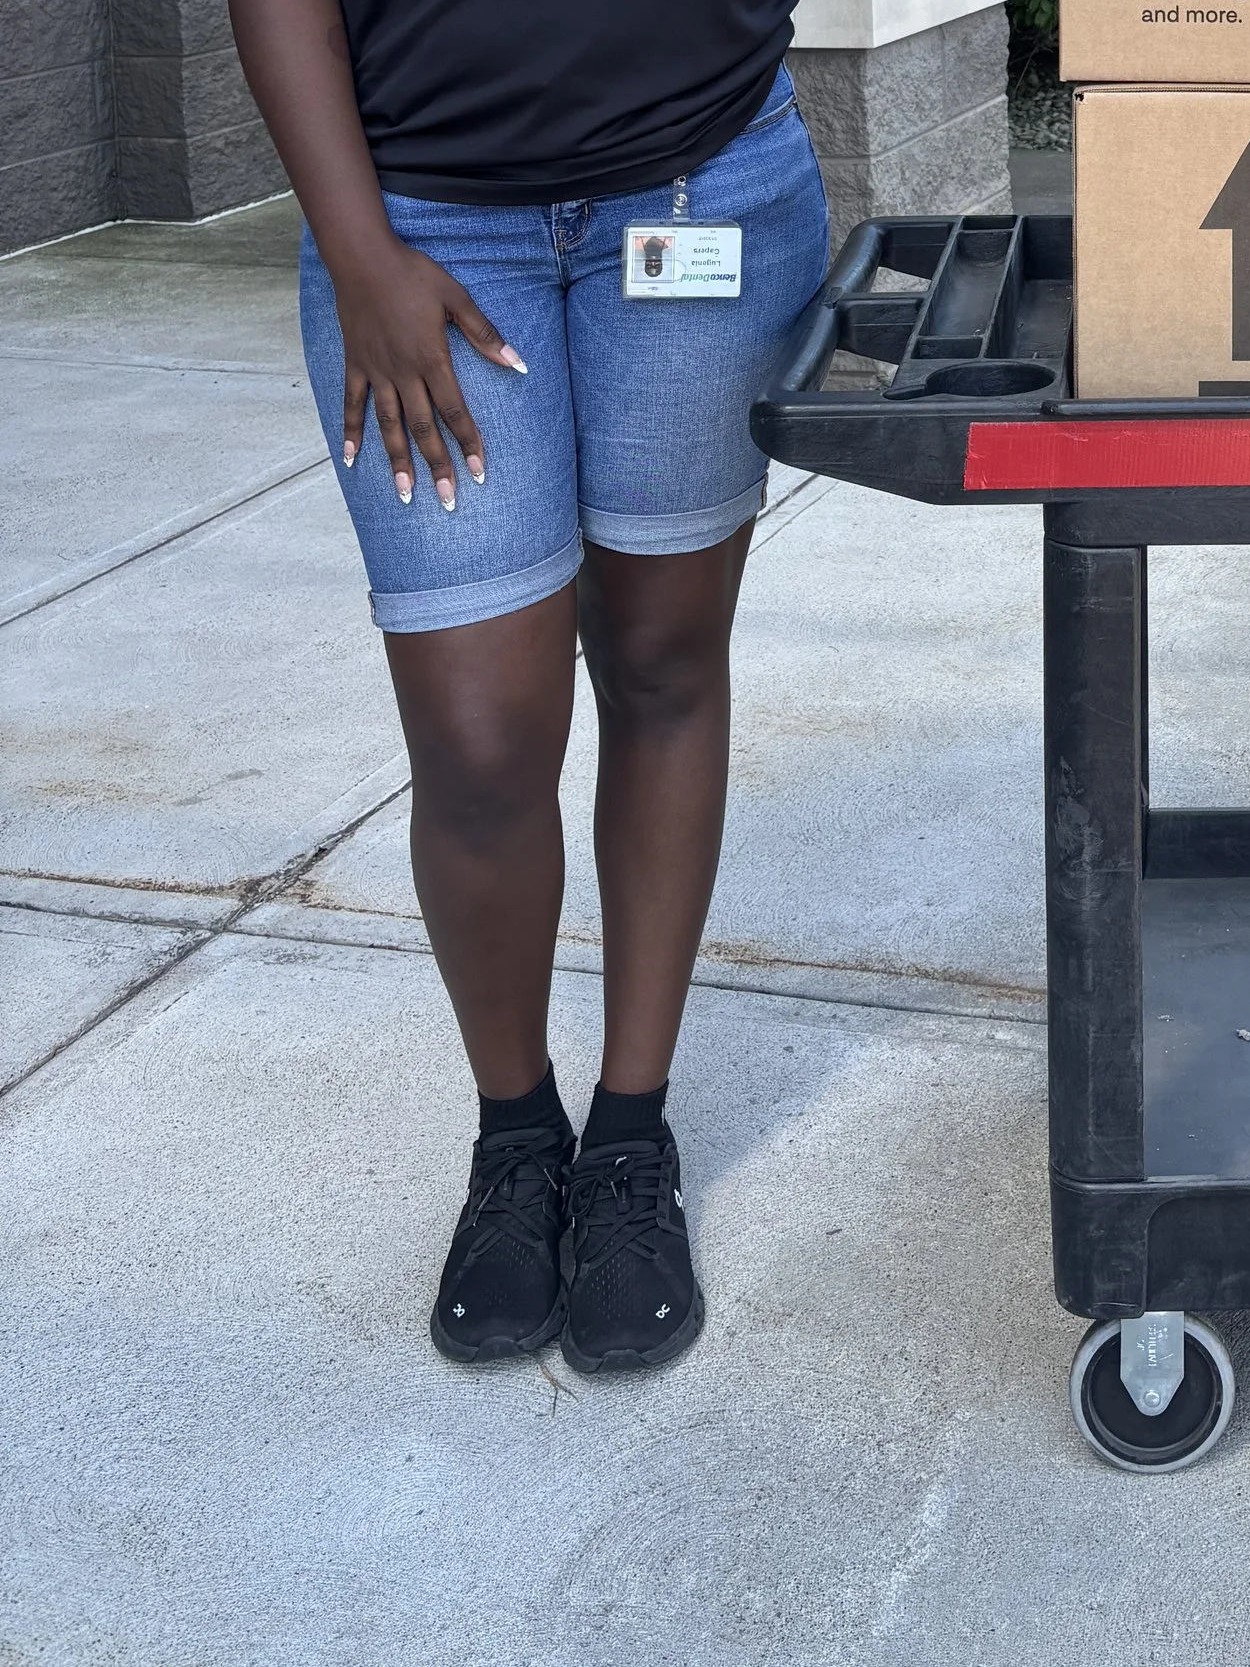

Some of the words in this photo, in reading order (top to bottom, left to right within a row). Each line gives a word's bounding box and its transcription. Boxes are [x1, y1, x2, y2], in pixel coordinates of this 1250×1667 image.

[1142, 5, 1179, 22] and
[1187, 10, 1242, 23] more.
[680, 273, 737, 283] BencoDental
